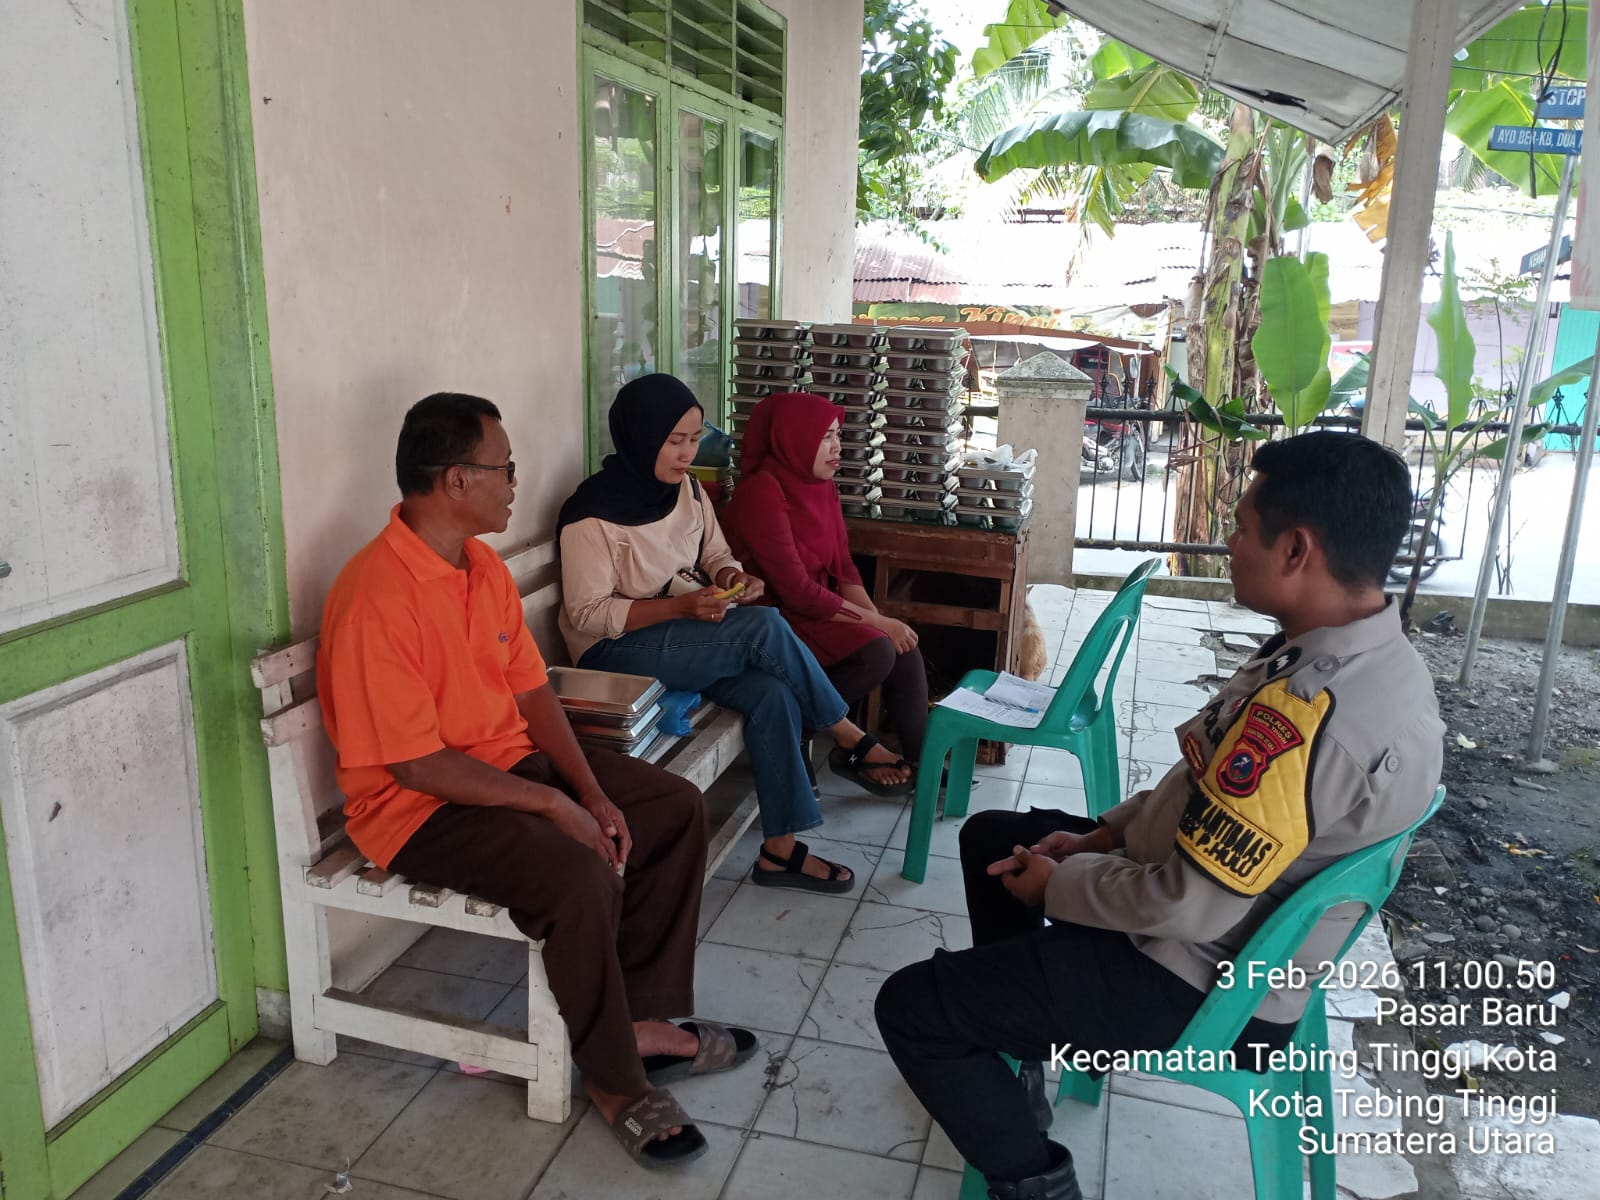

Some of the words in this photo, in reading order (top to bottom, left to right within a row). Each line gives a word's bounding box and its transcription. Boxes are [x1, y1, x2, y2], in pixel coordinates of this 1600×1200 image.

[1497, 129, 1516, 144] AYO
[1556, 132, 1576, 148] DUA
[1256, 710, 1293, 739] POLRES
